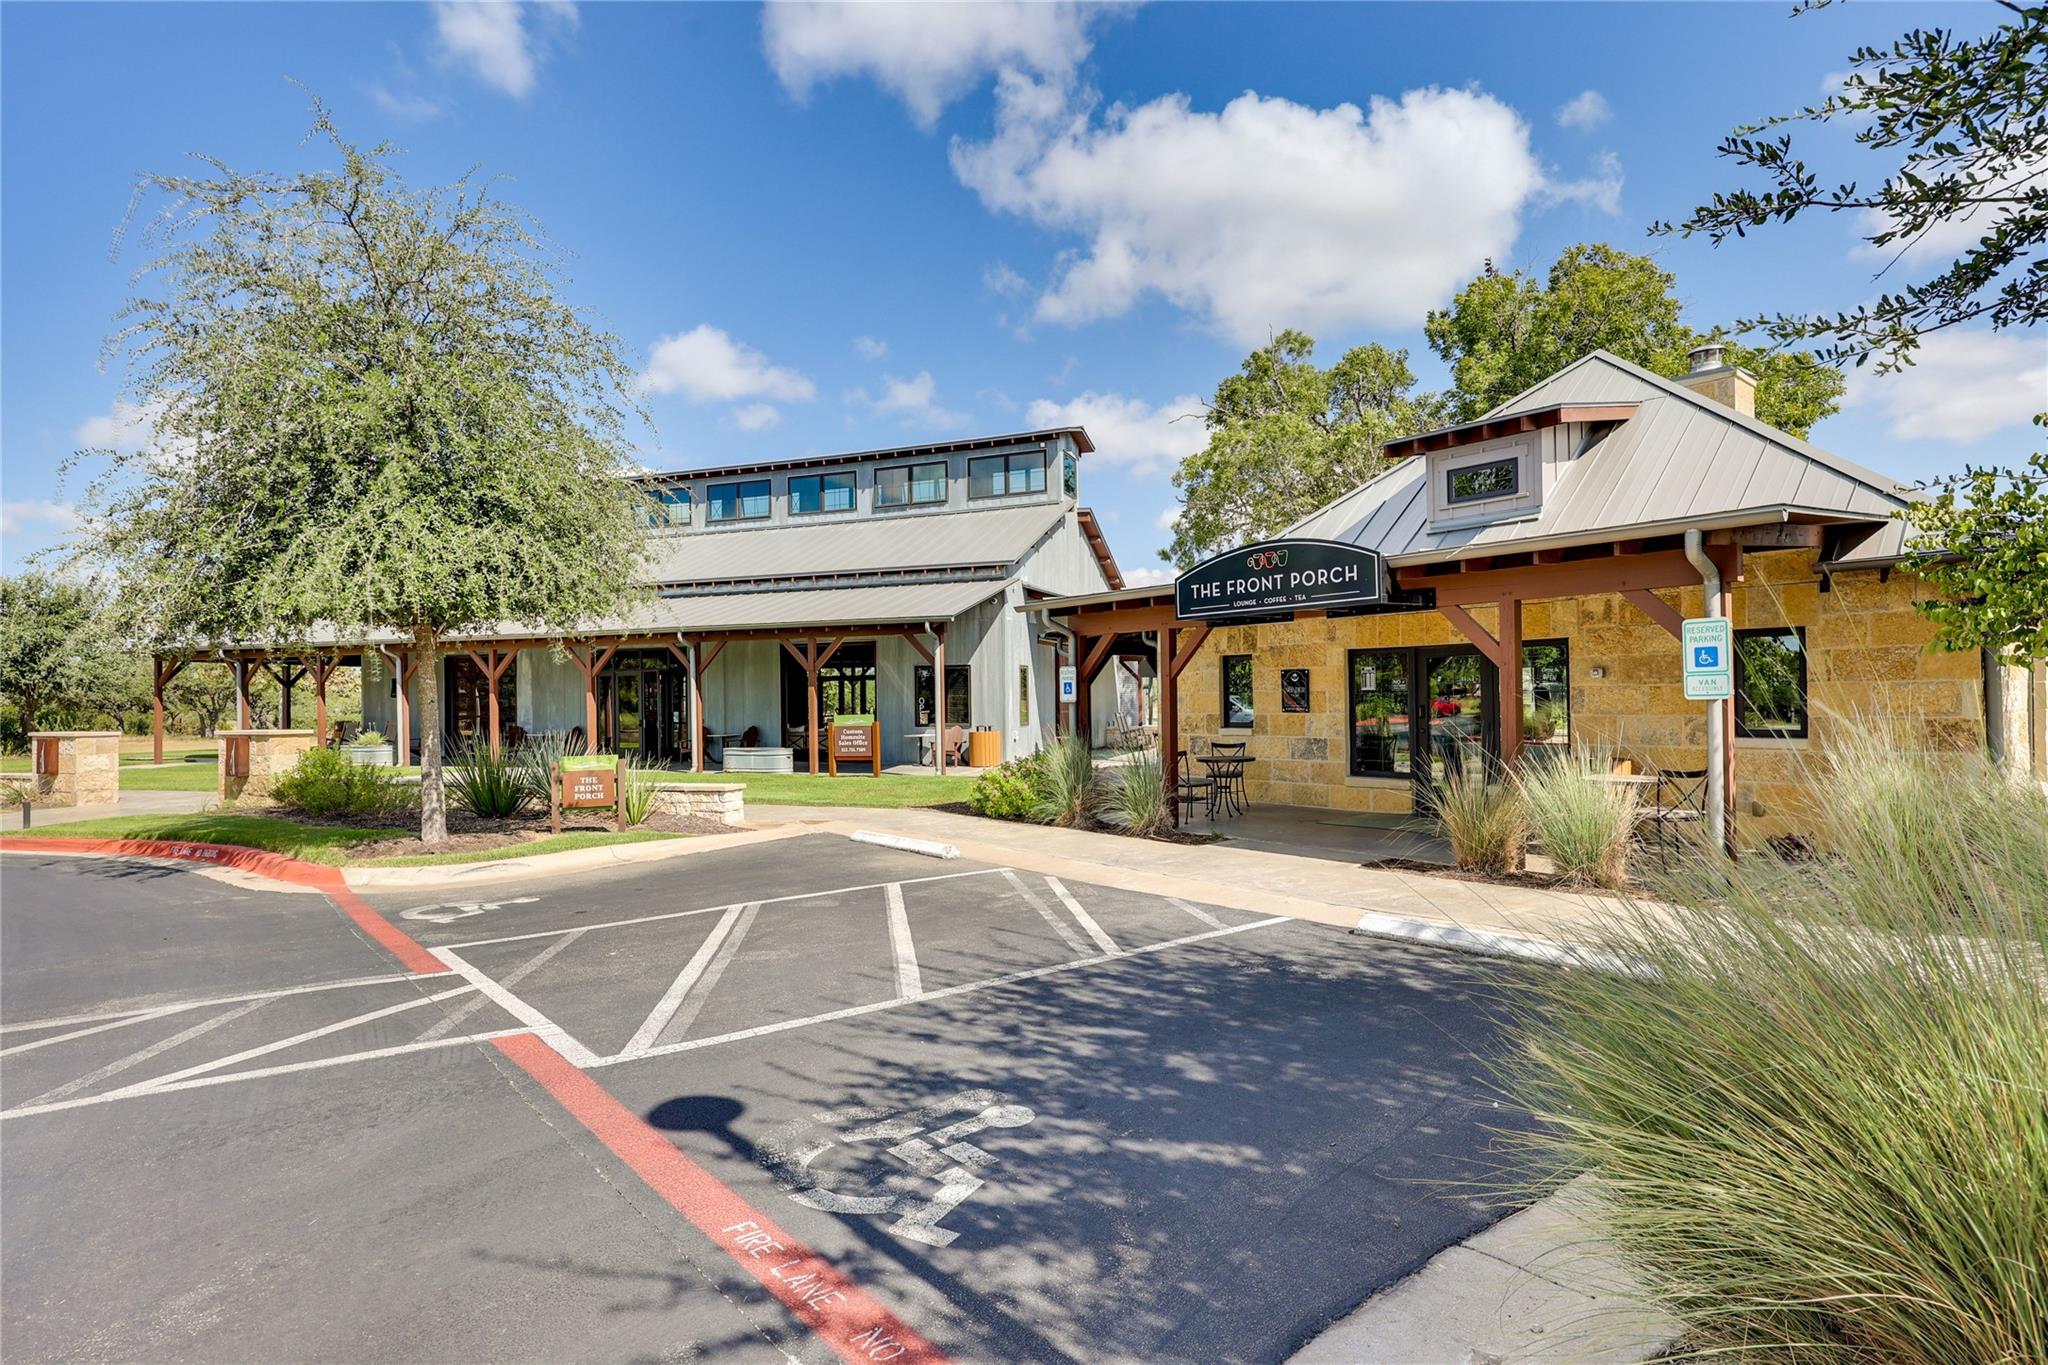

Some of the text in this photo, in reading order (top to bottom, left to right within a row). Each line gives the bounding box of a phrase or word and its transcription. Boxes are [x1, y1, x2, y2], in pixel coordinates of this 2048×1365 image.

[1190, 564, 1358, 599] THE FRONT PORCH
[1233, 598, 1257, 608] LOUNGE
[1263, 596, 1287, 604] COFFEE
[1686, 625, 1725, 634] RESERVED
[1689, 634, 1723, 643] PARKING
[580, 776, 598, 784] THE
[574, 784, 605, 792] FRONT
[574, 792, 605, 800] PORCH
[722, 1220, 905, 1361] FIRE LANE NO
